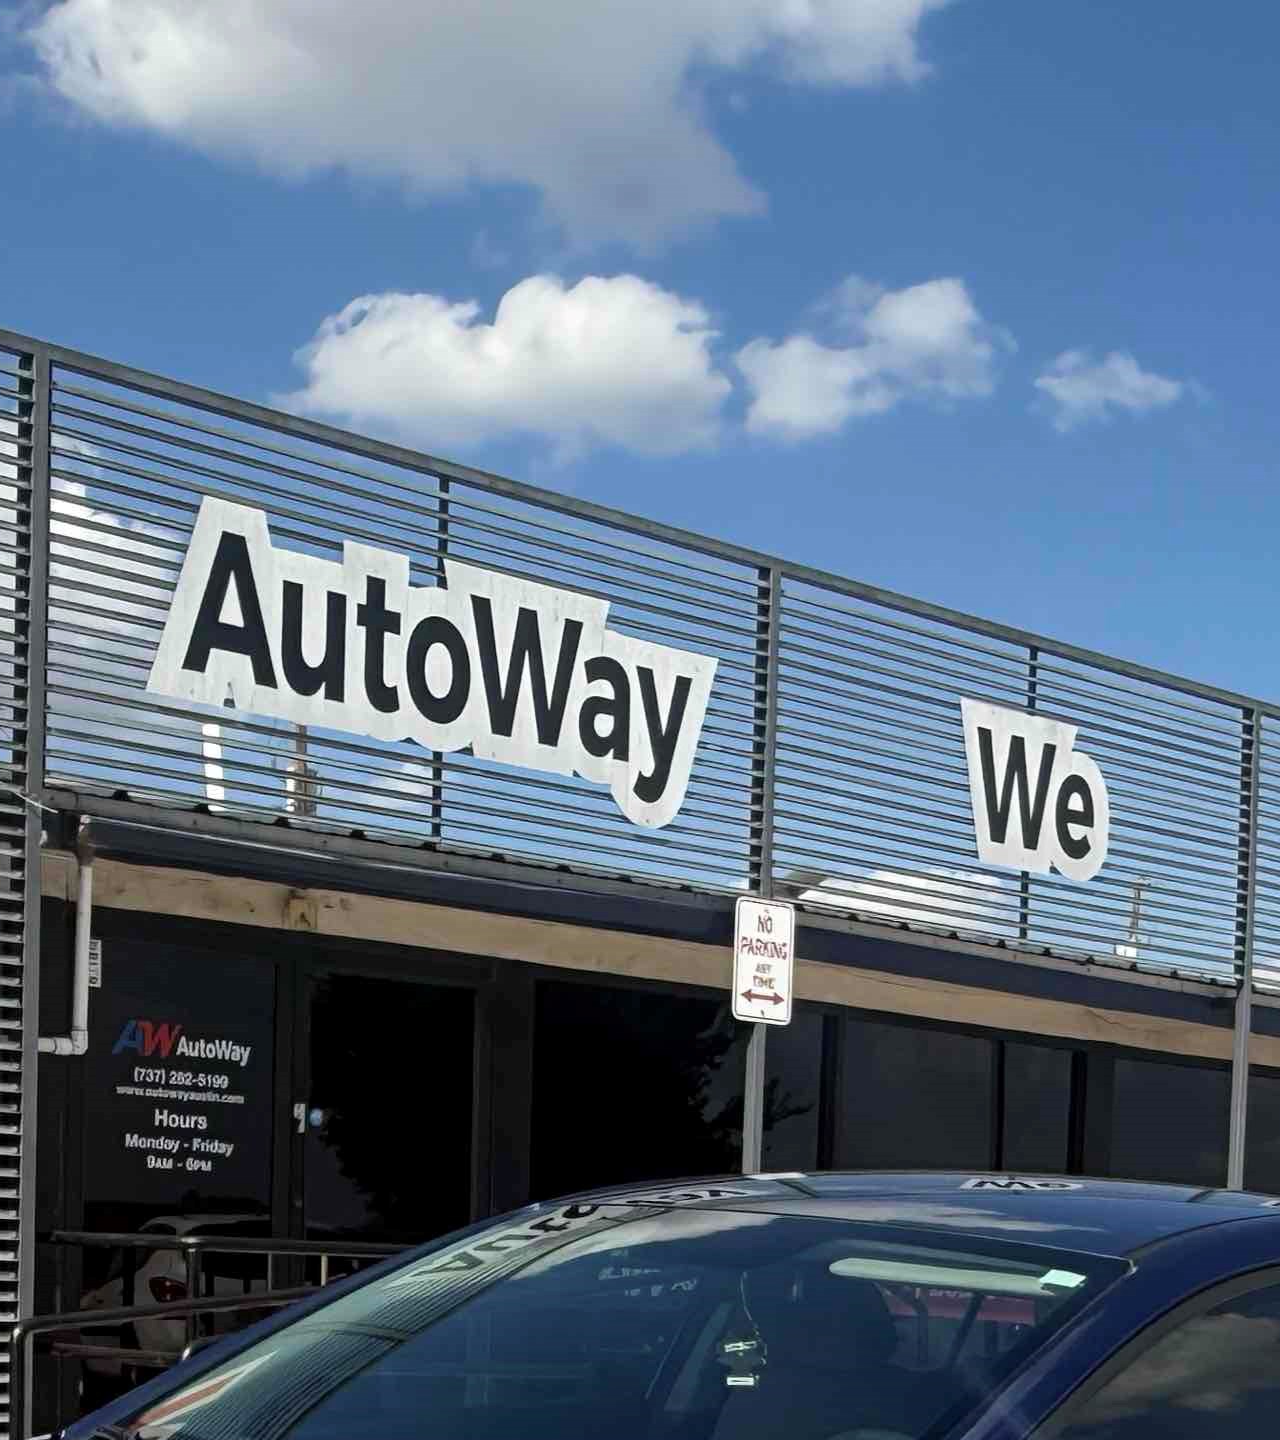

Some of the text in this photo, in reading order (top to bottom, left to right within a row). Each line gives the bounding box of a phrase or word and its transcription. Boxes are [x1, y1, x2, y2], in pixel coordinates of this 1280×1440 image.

[182, 531, 692, 803] AutoWay
[977, 726, 1094, 861] We
[757, 915, 773, 933] NO
[741, 937, 787, 960] PARKING
[753, 976, 774, 989] TIME
[112, 1018, 252, 1067] AW AutoWay
[134, 1066, 166, 1085] (737)
[154, 1108, 208, 1130] Hours
[125, 1133, 180, 1154] Monday
[192, 1137, 234, 1157] Friday
